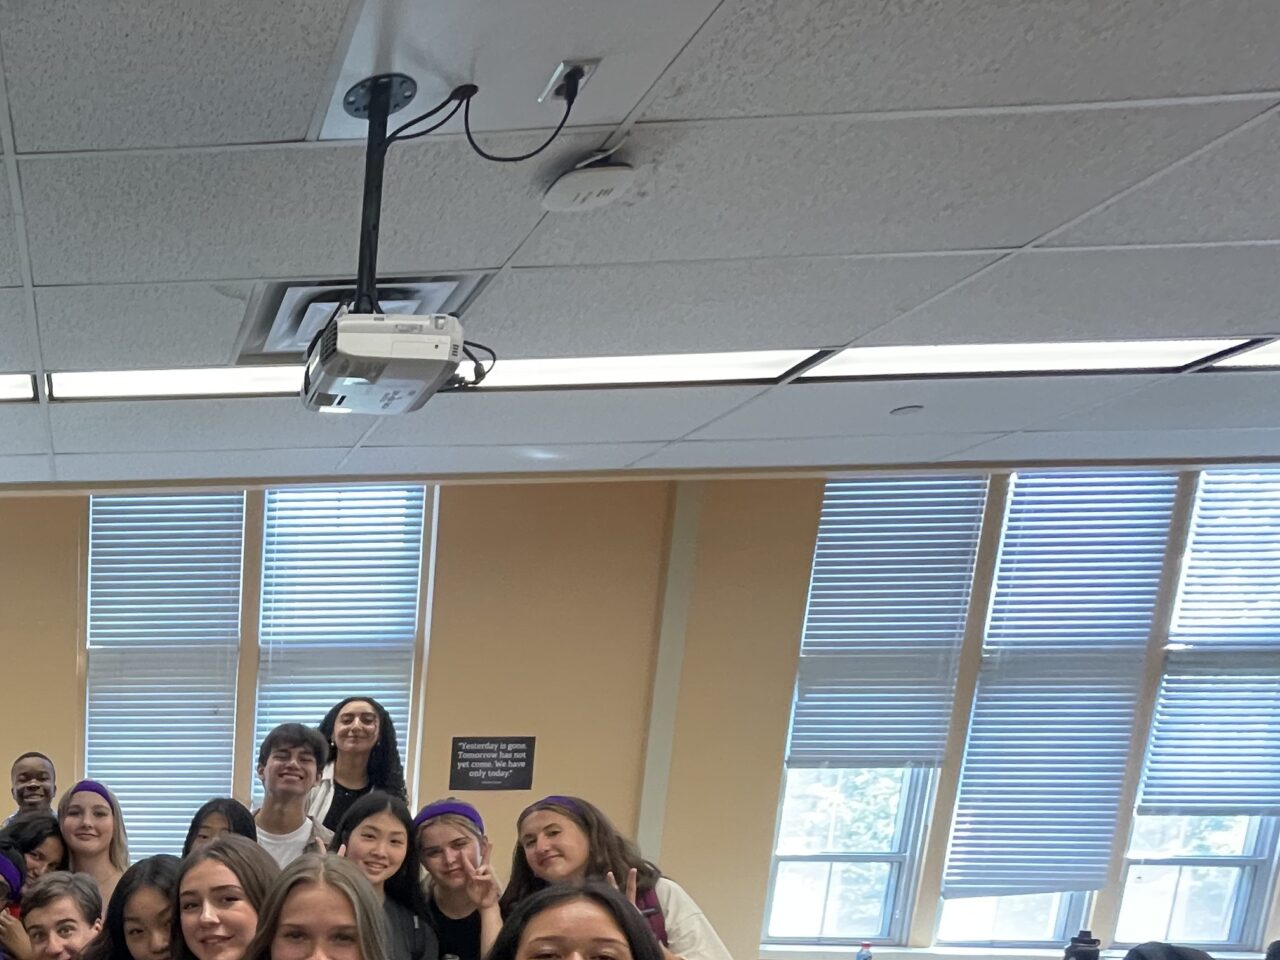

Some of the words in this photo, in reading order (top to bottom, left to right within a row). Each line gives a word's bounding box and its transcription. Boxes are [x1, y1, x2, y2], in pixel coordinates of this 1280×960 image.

[500, 742, 507, 750] is
[458, 751, 498, 759] Tomorrow
[500, 751, 513, 759] has
[457, 761, 469, 770] yet
[494, 760, 507, 768] We
[508, 760, 526, 768] have
[469, 769, 486, 778] only
